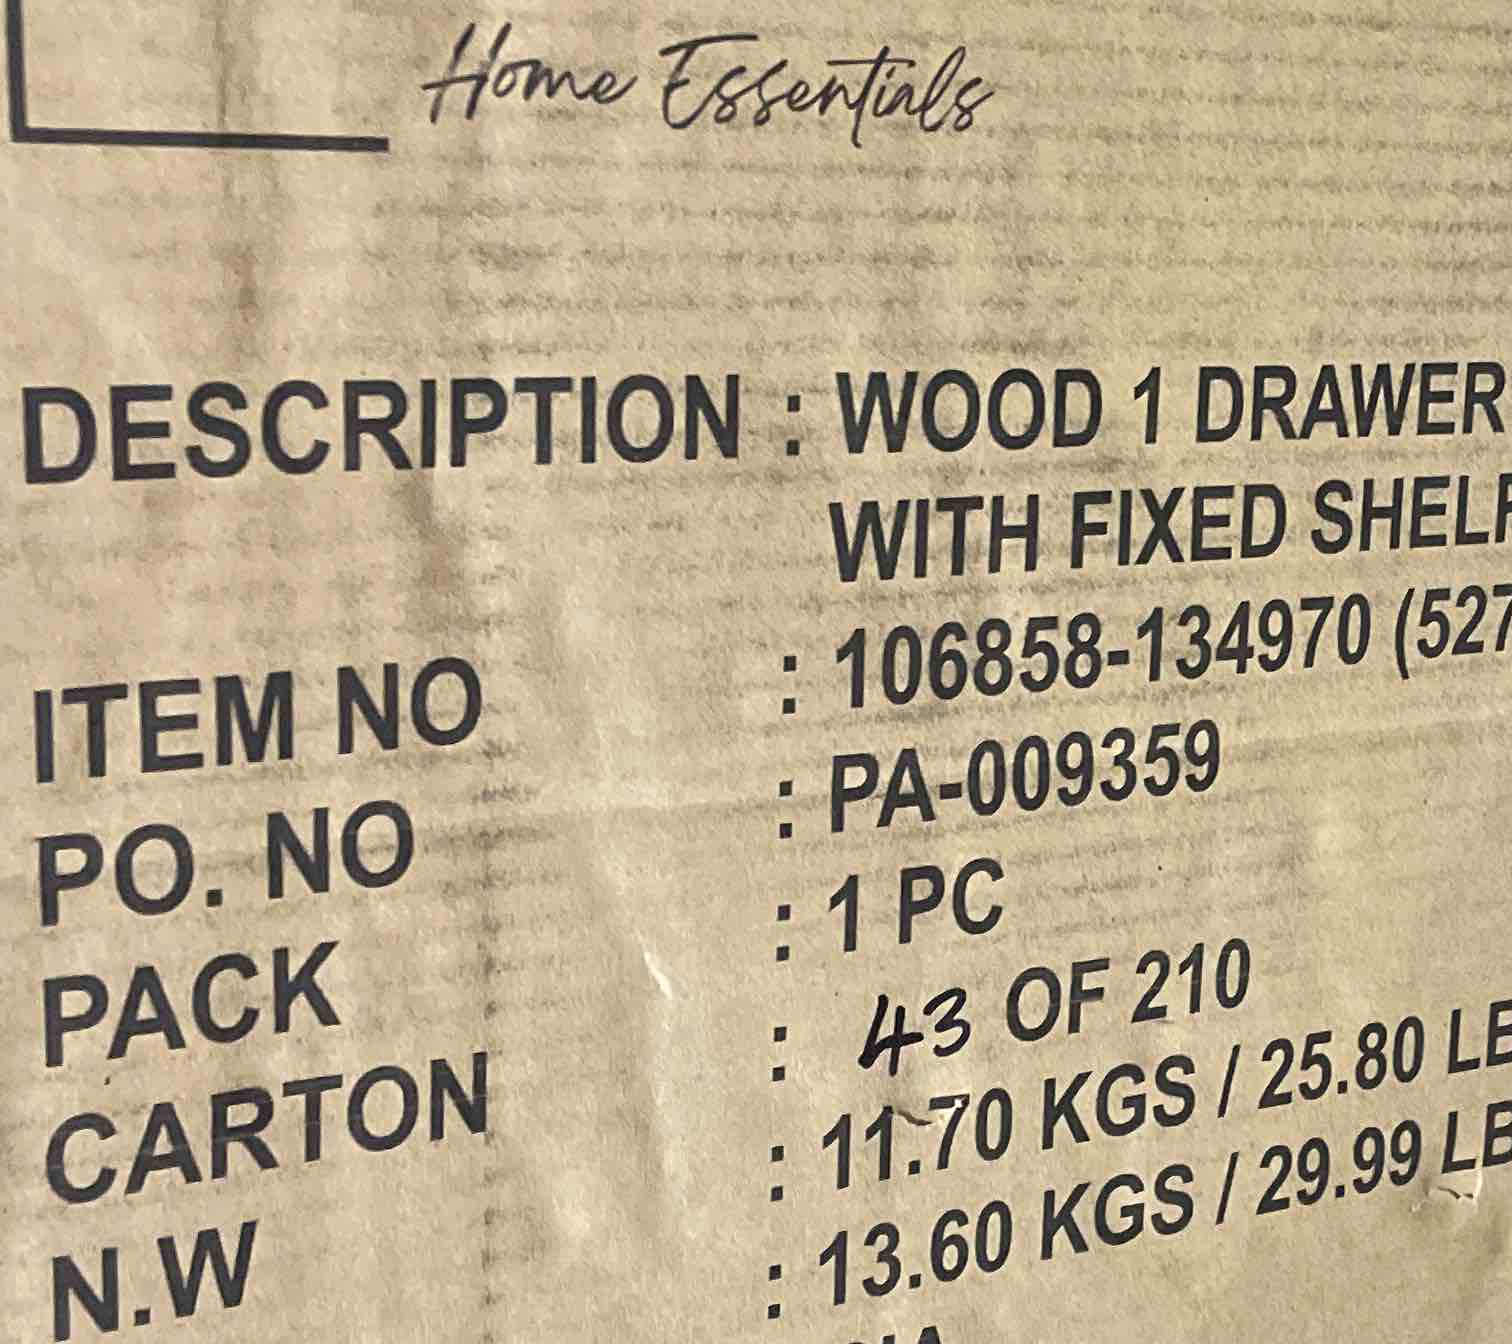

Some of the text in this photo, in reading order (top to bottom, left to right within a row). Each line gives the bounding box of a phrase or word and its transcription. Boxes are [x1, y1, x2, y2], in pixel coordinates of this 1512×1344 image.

[421, 23, 995, 148] Home Essentials
[22, 374, 740, 484] DESCRIPTION
[836, 369, 1102, 453] WOOD
[1134, 367, 1160, 444] 1
[1196, 362, 1505, 442] DRAWER
[829, 494, 1039, 582] WITH
[1071, 484, 1286, 568] FIXED
[34, 671, 293, 783] ITEM
[338, 657, 482, 754] NO
[837, 594, 1370, 708] 106858-134970
[35, 824, 222, 926] PO.
[267, 800, 413, 899] NO
[831, 720, 1219, 833] PA-009359
[43, 941, 340, 1067] PACK
[829, 875, 858, 952] 1
[899, 858, 1004, 944] PC
[46, 1051, 488, 1204] CARTON
[858, 987, 970, 1077] 43
[1007, 958, 1110, 1041] OF
[1131, 938, 1250, 1023] 210
[52, 1220, 257, 1342] N.W
[823, 1088, 1012, 1189] 11.70
[1042, 1055, 1195, 1150] KGS
[1218, 1045, 1240, 1118] /
[1258, 1016, 1424, 1109] 25.80
[819, 1200, 1012, 1306] 13.60
[1041, 1164, 1193, 1260] KGS
[1216, 1152, 1239, 1225] /
[1256, 1120, 1421, 1215] 29.99
